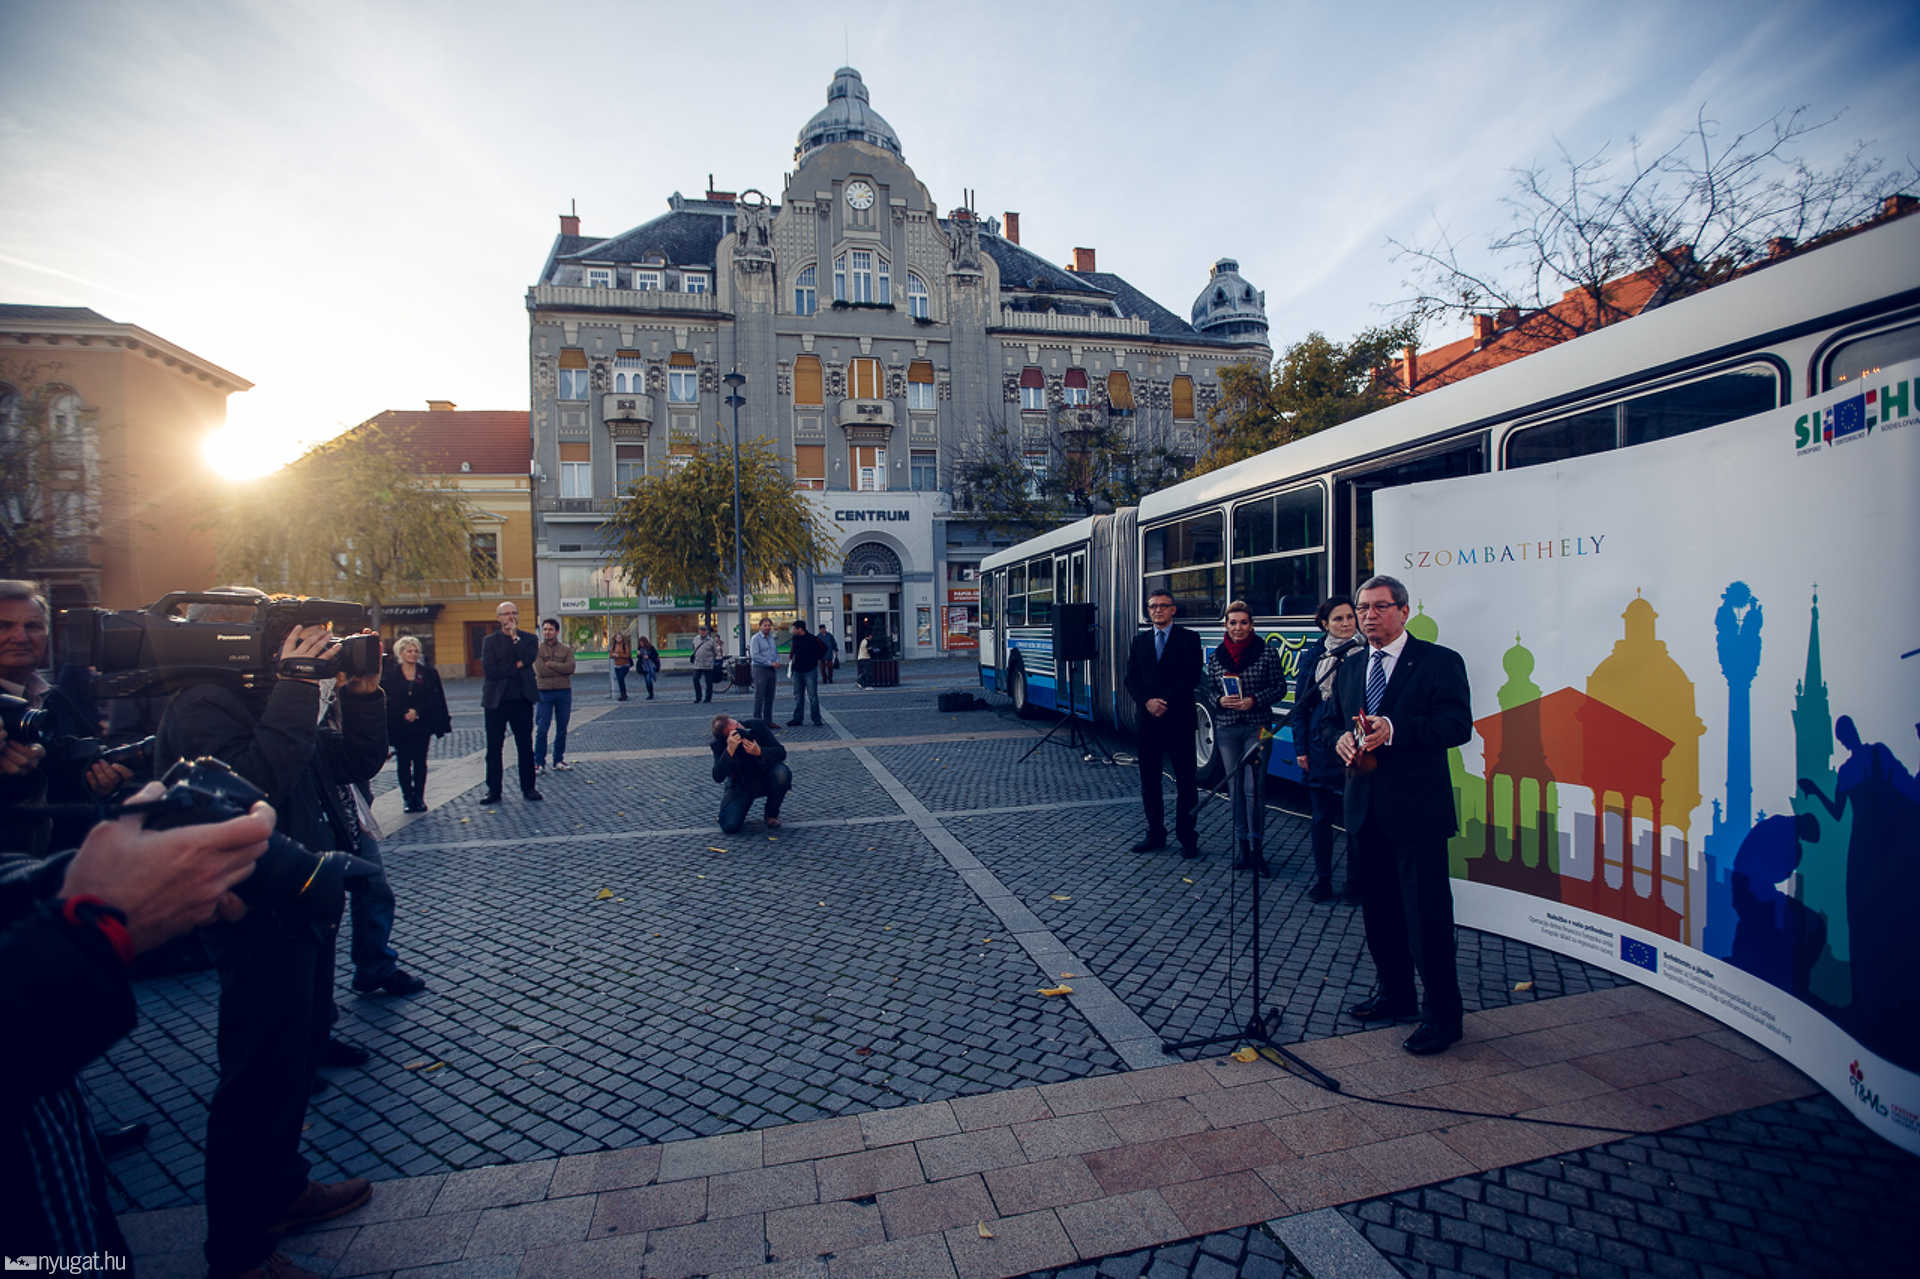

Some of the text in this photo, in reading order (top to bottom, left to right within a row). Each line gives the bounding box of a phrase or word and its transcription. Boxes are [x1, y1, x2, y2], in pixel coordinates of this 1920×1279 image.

[1881, 378, 1920, 422] H
[835, 510, 909, 521] CENTRUM
[1404, 534, 1605, 569] SZOMBATHELY
